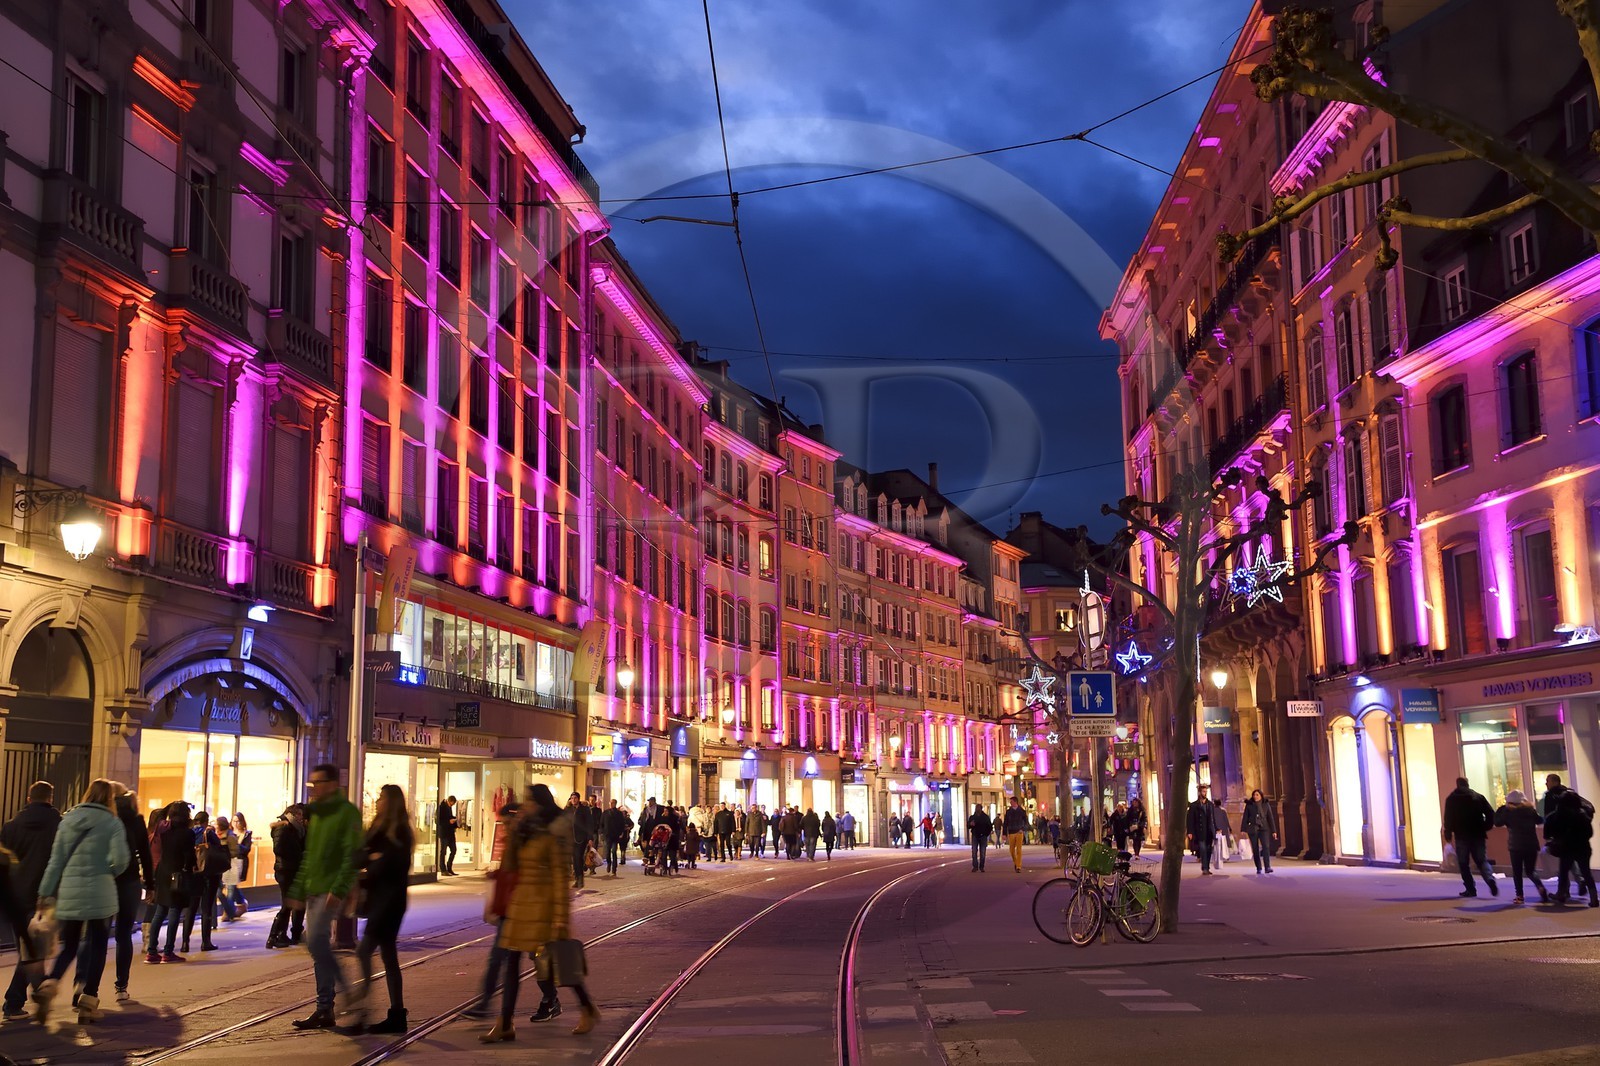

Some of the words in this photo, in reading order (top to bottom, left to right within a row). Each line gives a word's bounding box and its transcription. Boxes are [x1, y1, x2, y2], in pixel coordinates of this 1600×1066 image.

[400, 556, 413, 598] OPTICIEN
[595, 628, 607, 658] OPTICIEN
[1483, 680, 1526, 697] HAVAS
[1526, 672, 1593, 692] VOYAGES
[201, 698, 249, 721] Christofle
[457, 711, 478, 719] Marc
[461, 704, 478, 713] Karl
[457, 718, 478, 726] John
[373, 722, 384, 741] arl
[388, 723, 409, 744] Marc
[412, 726, 432, 746] John
